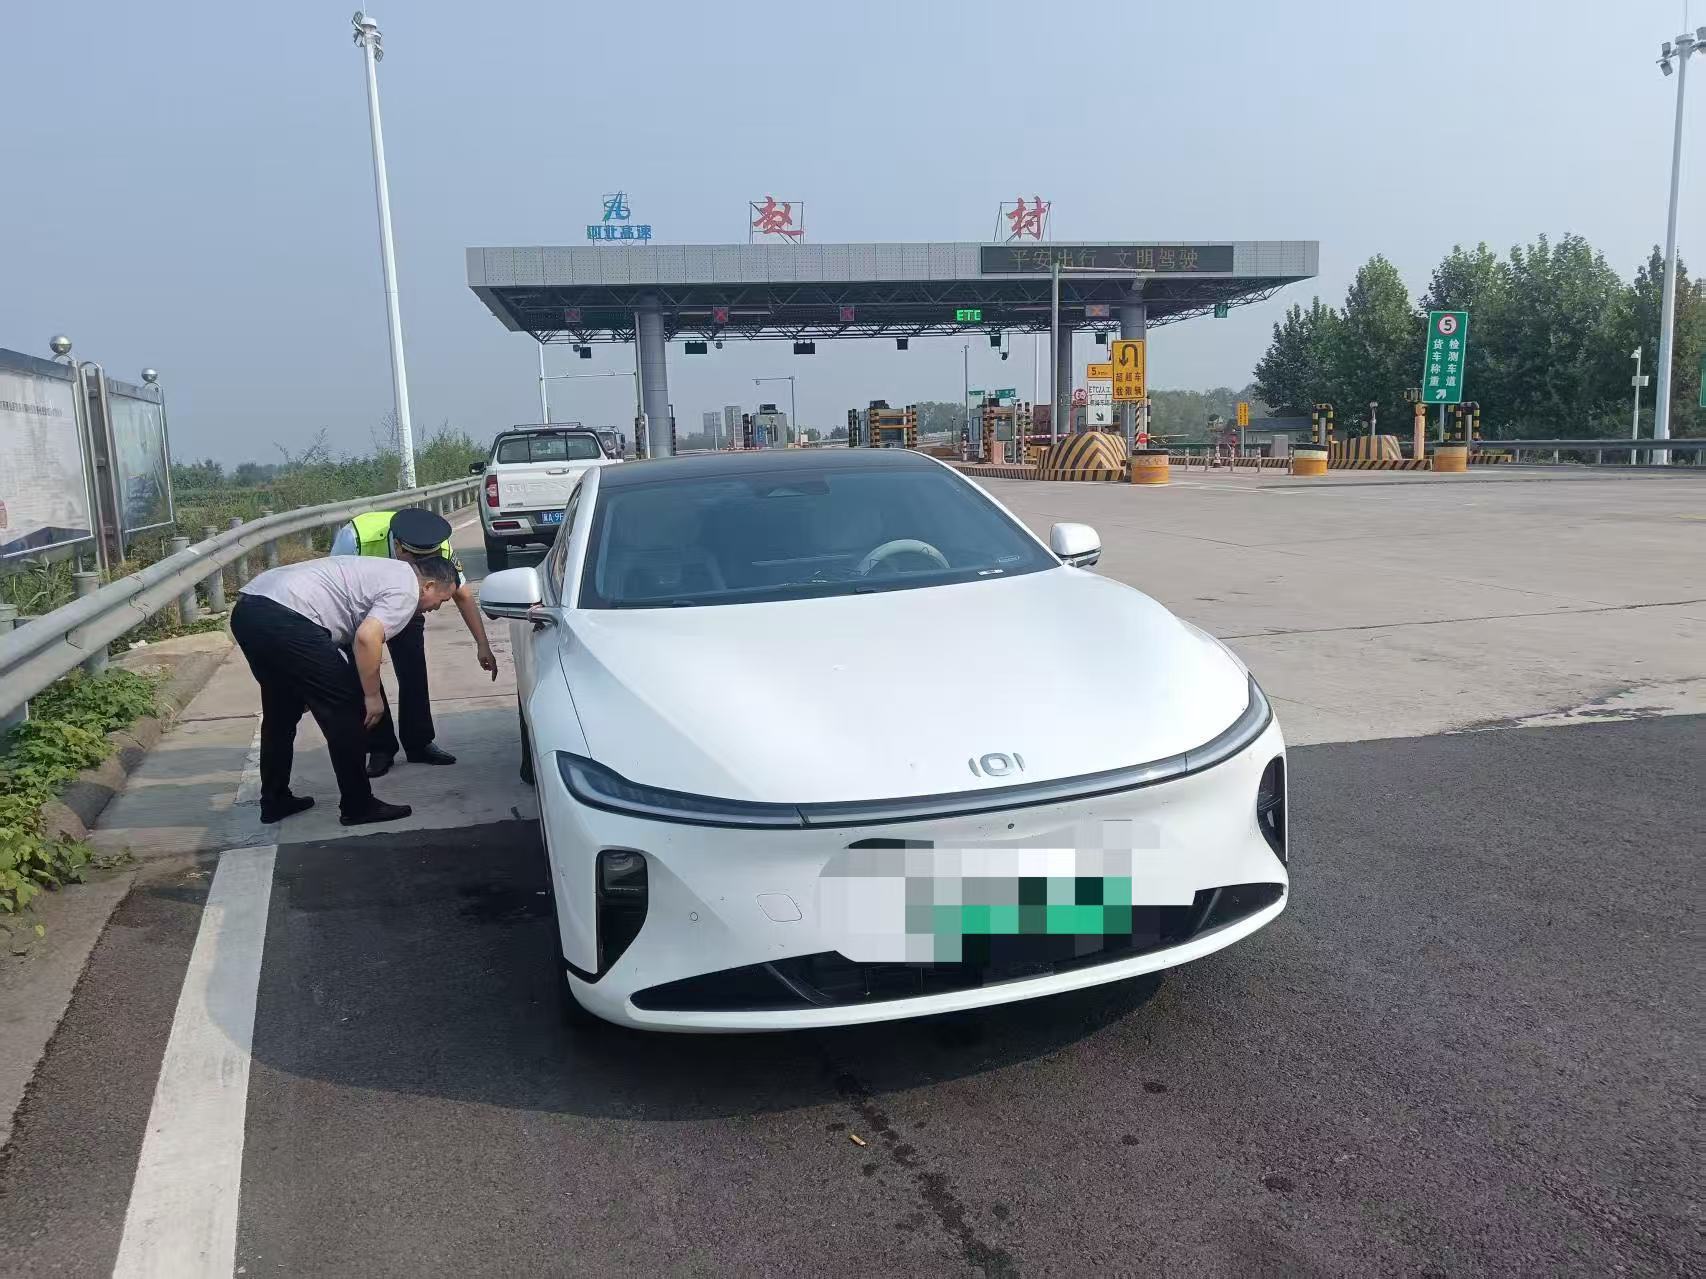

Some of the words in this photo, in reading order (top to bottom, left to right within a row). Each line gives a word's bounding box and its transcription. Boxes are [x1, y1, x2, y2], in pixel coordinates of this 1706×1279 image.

[753, 196, 804, 236] 赵
[1006, 196, 1047, 240] 村
[1008, 248, 1097, 268] 平安出行
[1113, 249, 1200, 270] 文明驾驶
[956, 309, 981, 321] ETC
[1443, 319, 1452, 331] 5
[1428, 338, 1444, 387] 货车称重
[1445, 338, 1460, 387] 检测车道
